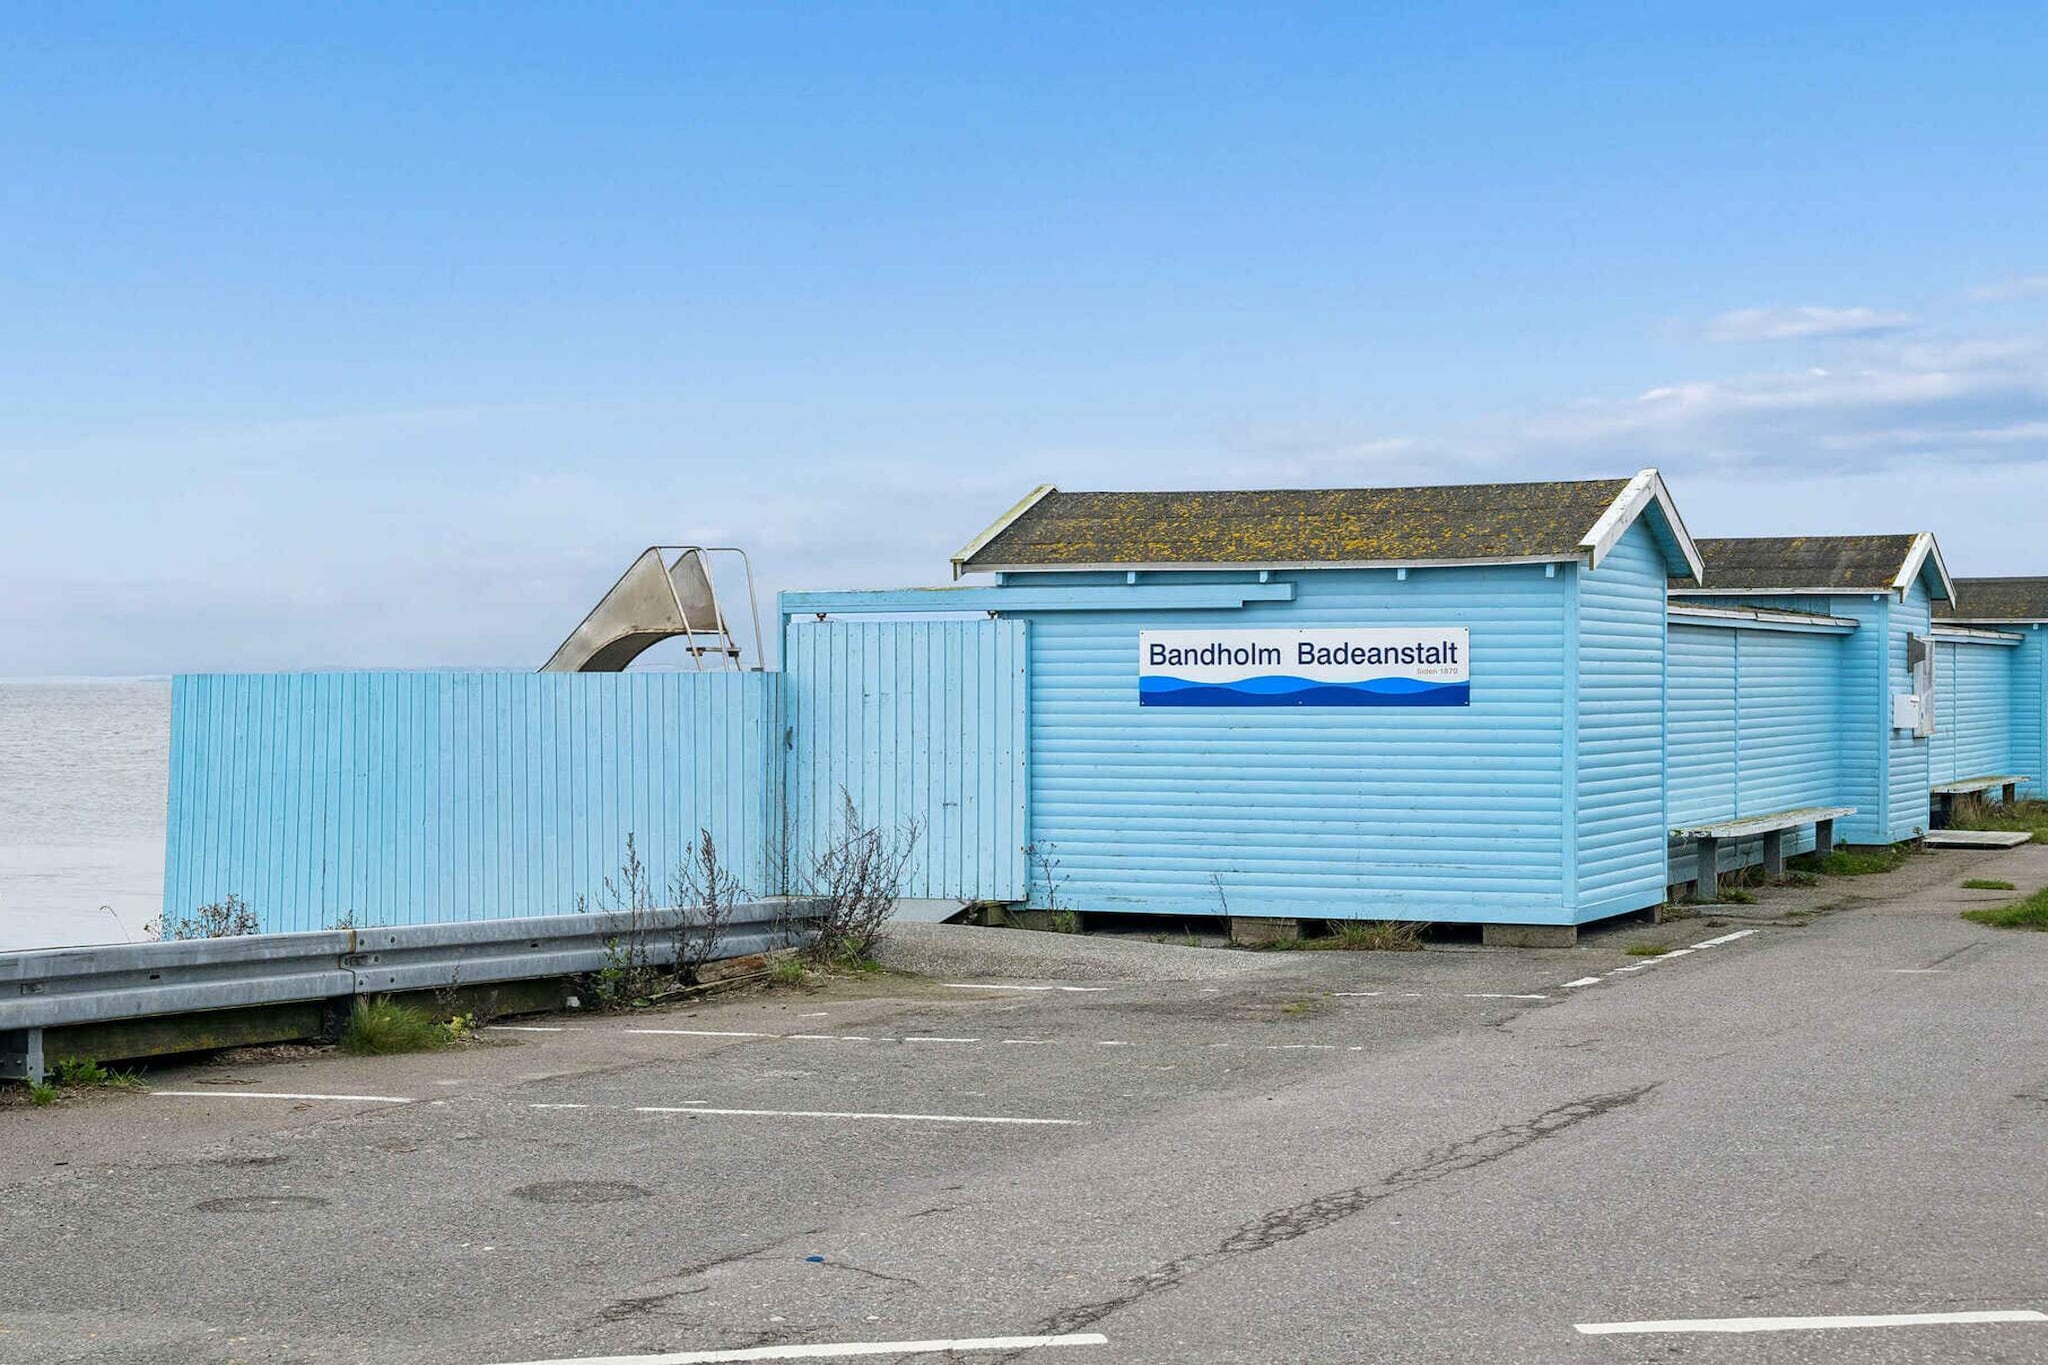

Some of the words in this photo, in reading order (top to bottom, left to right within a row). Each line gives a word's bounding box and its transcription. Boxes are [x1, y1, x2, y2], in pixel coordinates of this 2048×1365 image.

[1150, 642, 1281, 666] Bandholm
[1298, 641, 1459, 665] Badeanstalt
[1417, 667, 1438, 675] Siden
